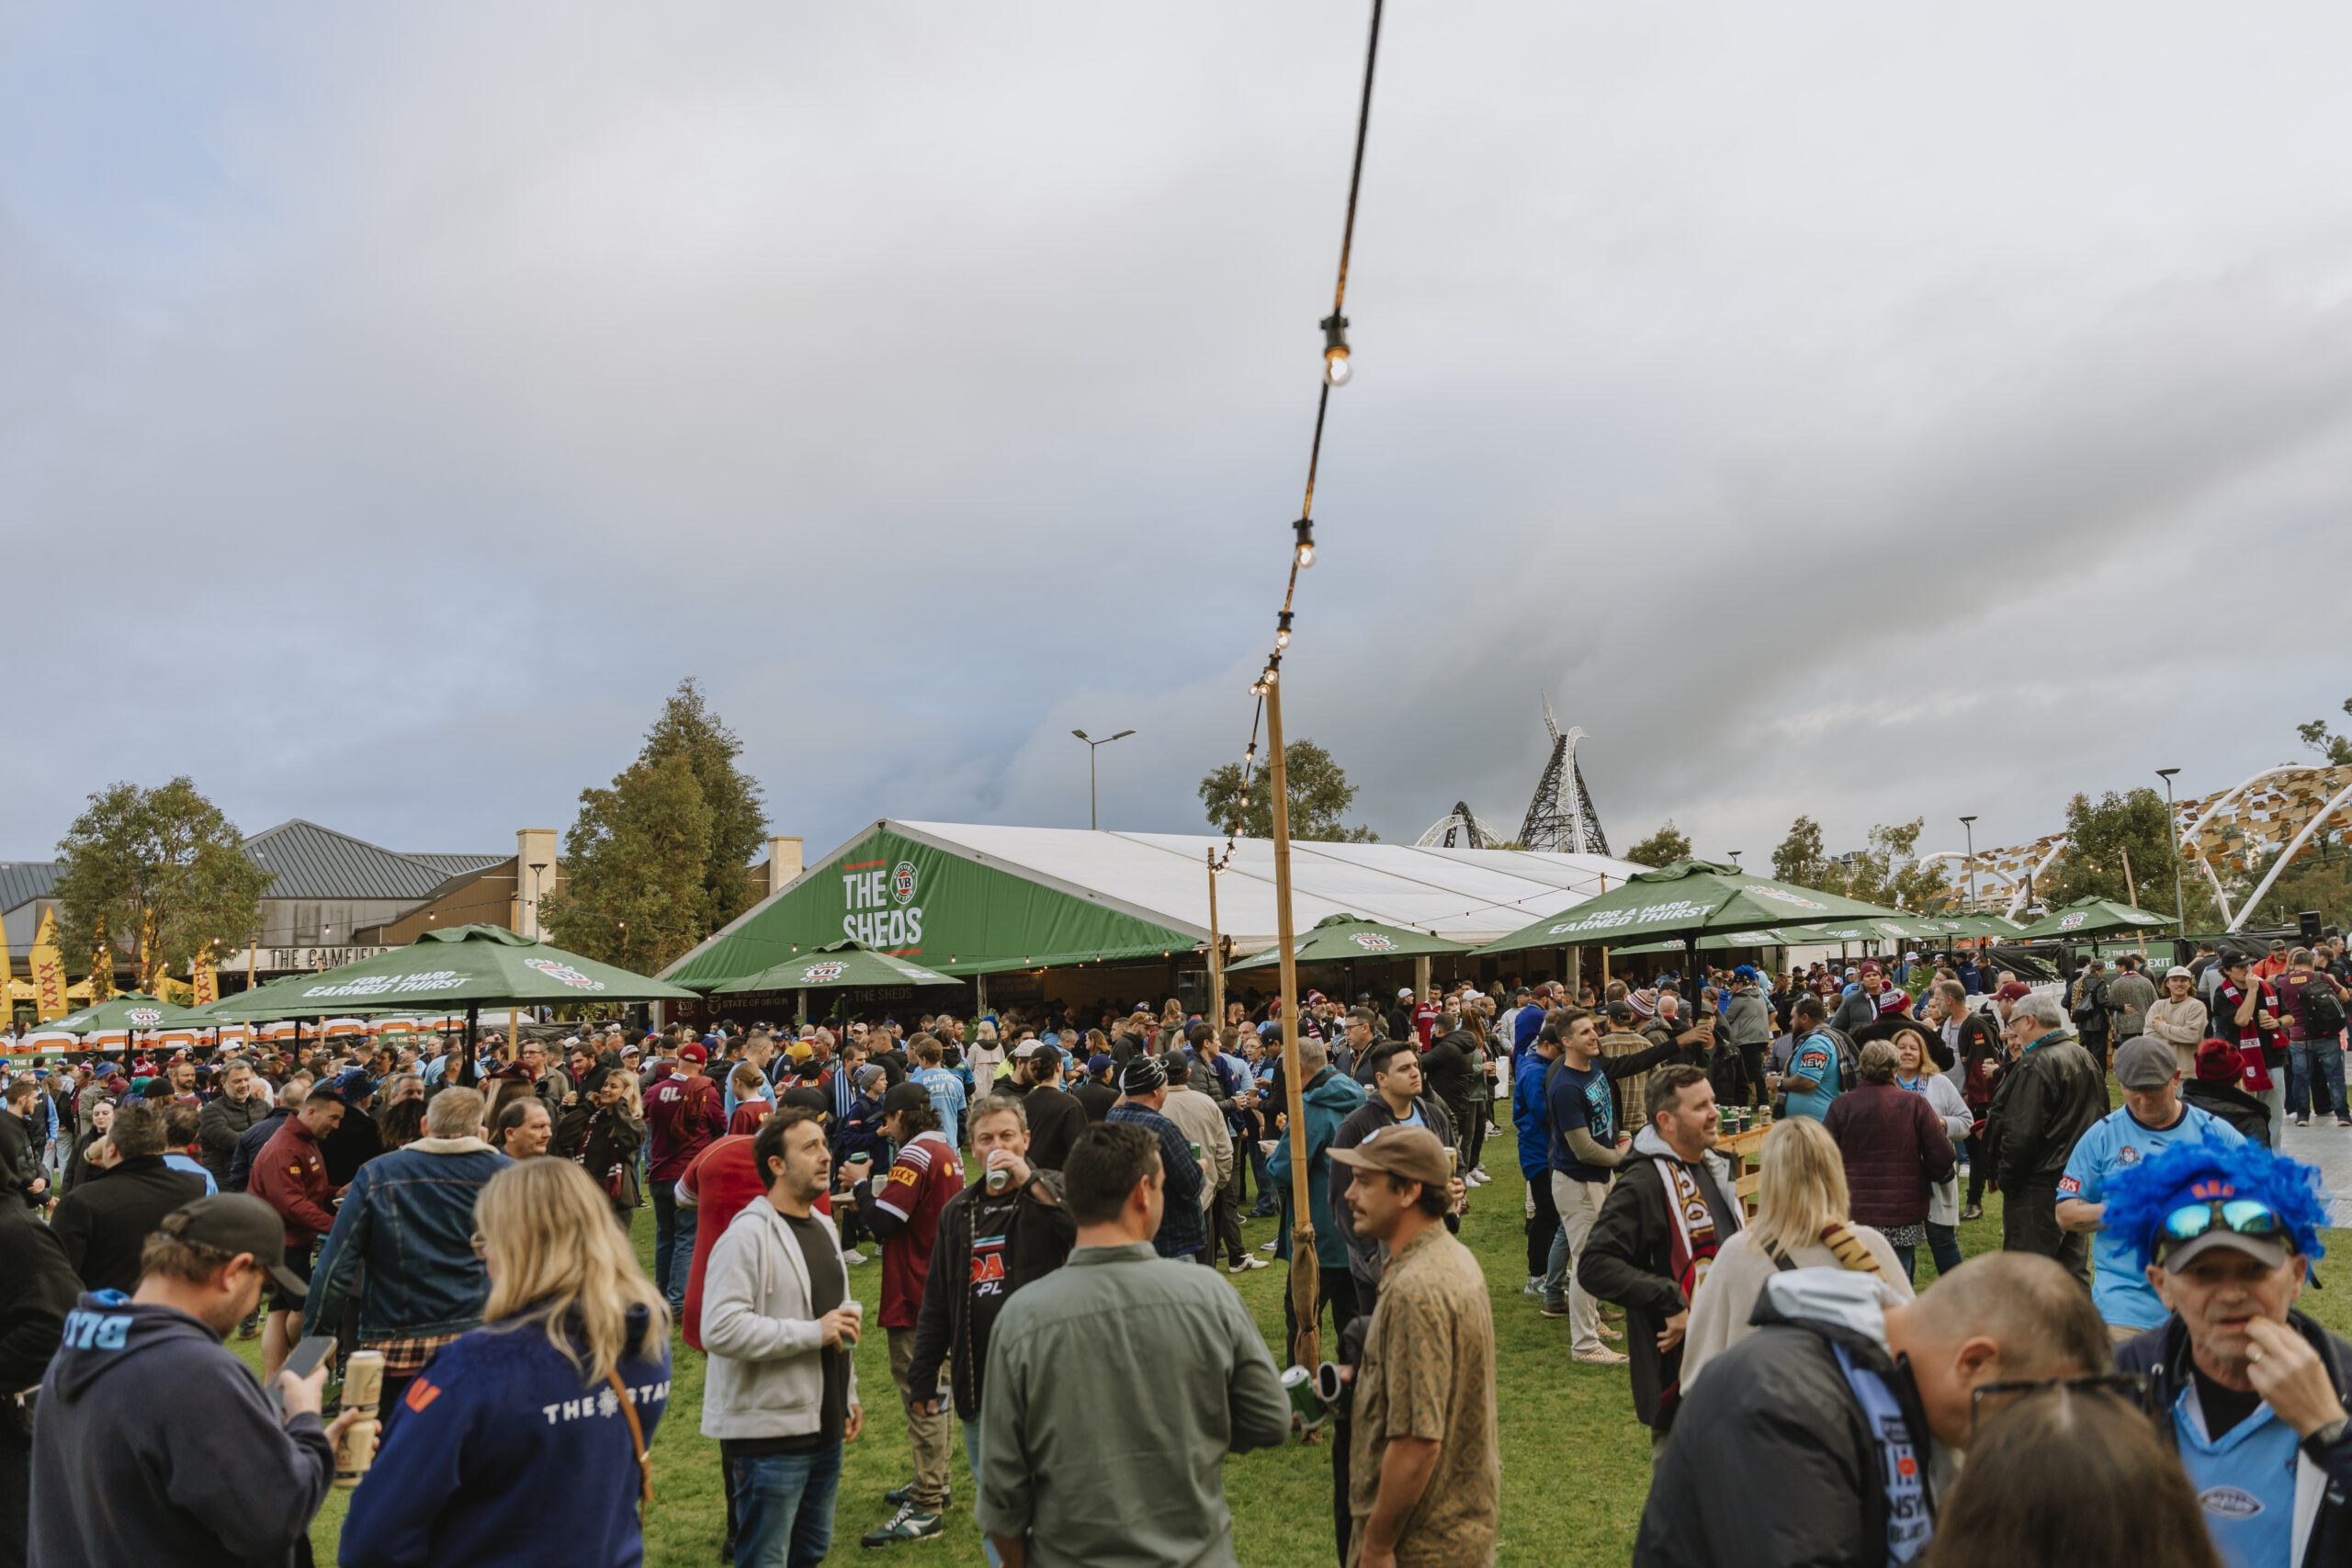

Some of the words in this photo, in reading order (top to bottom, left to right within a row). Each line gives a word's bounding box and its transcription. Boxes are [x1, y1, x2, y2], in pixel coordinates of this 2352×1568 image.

[842, 871, 887, 909] THE
[899, 877, 911, 888] VB
[1548, 916, 1633, 934] EARNED
[1636, 904, 1715, 924] THIRST
[1587, 910, 1623, 920] FOR
[1623, 908, 1637, 917] A
[1640, 900, 1691, 915] HARD
[842, 907, 922, 948] SHEDS
[271, 949, 300, 968] THE
[309, 948, 388, 967] CAMFIE
[2147, 957, 2171, 968] EXIT
[39, 961, 59, 1010] XXXX
[301, 985, 392, 998] EARNED
[392, 978, 472, 993] THIRST
[348, 976, 389, 986] FOR
[386, 975, 402, 984] A
[402, 971, 457, 982] HARD
[722, 999, 748, 1008] STATE
[750, 998, 760, 1007] OF
[762, 998, 788, 1006] ORIGIN
[854, 989, 876, 1002] THE
[878, 987, 911, 1000] SHEDS
[1801, 1059, 1826, 1069] NEW
[543, 1396, 595, 1425] THE
